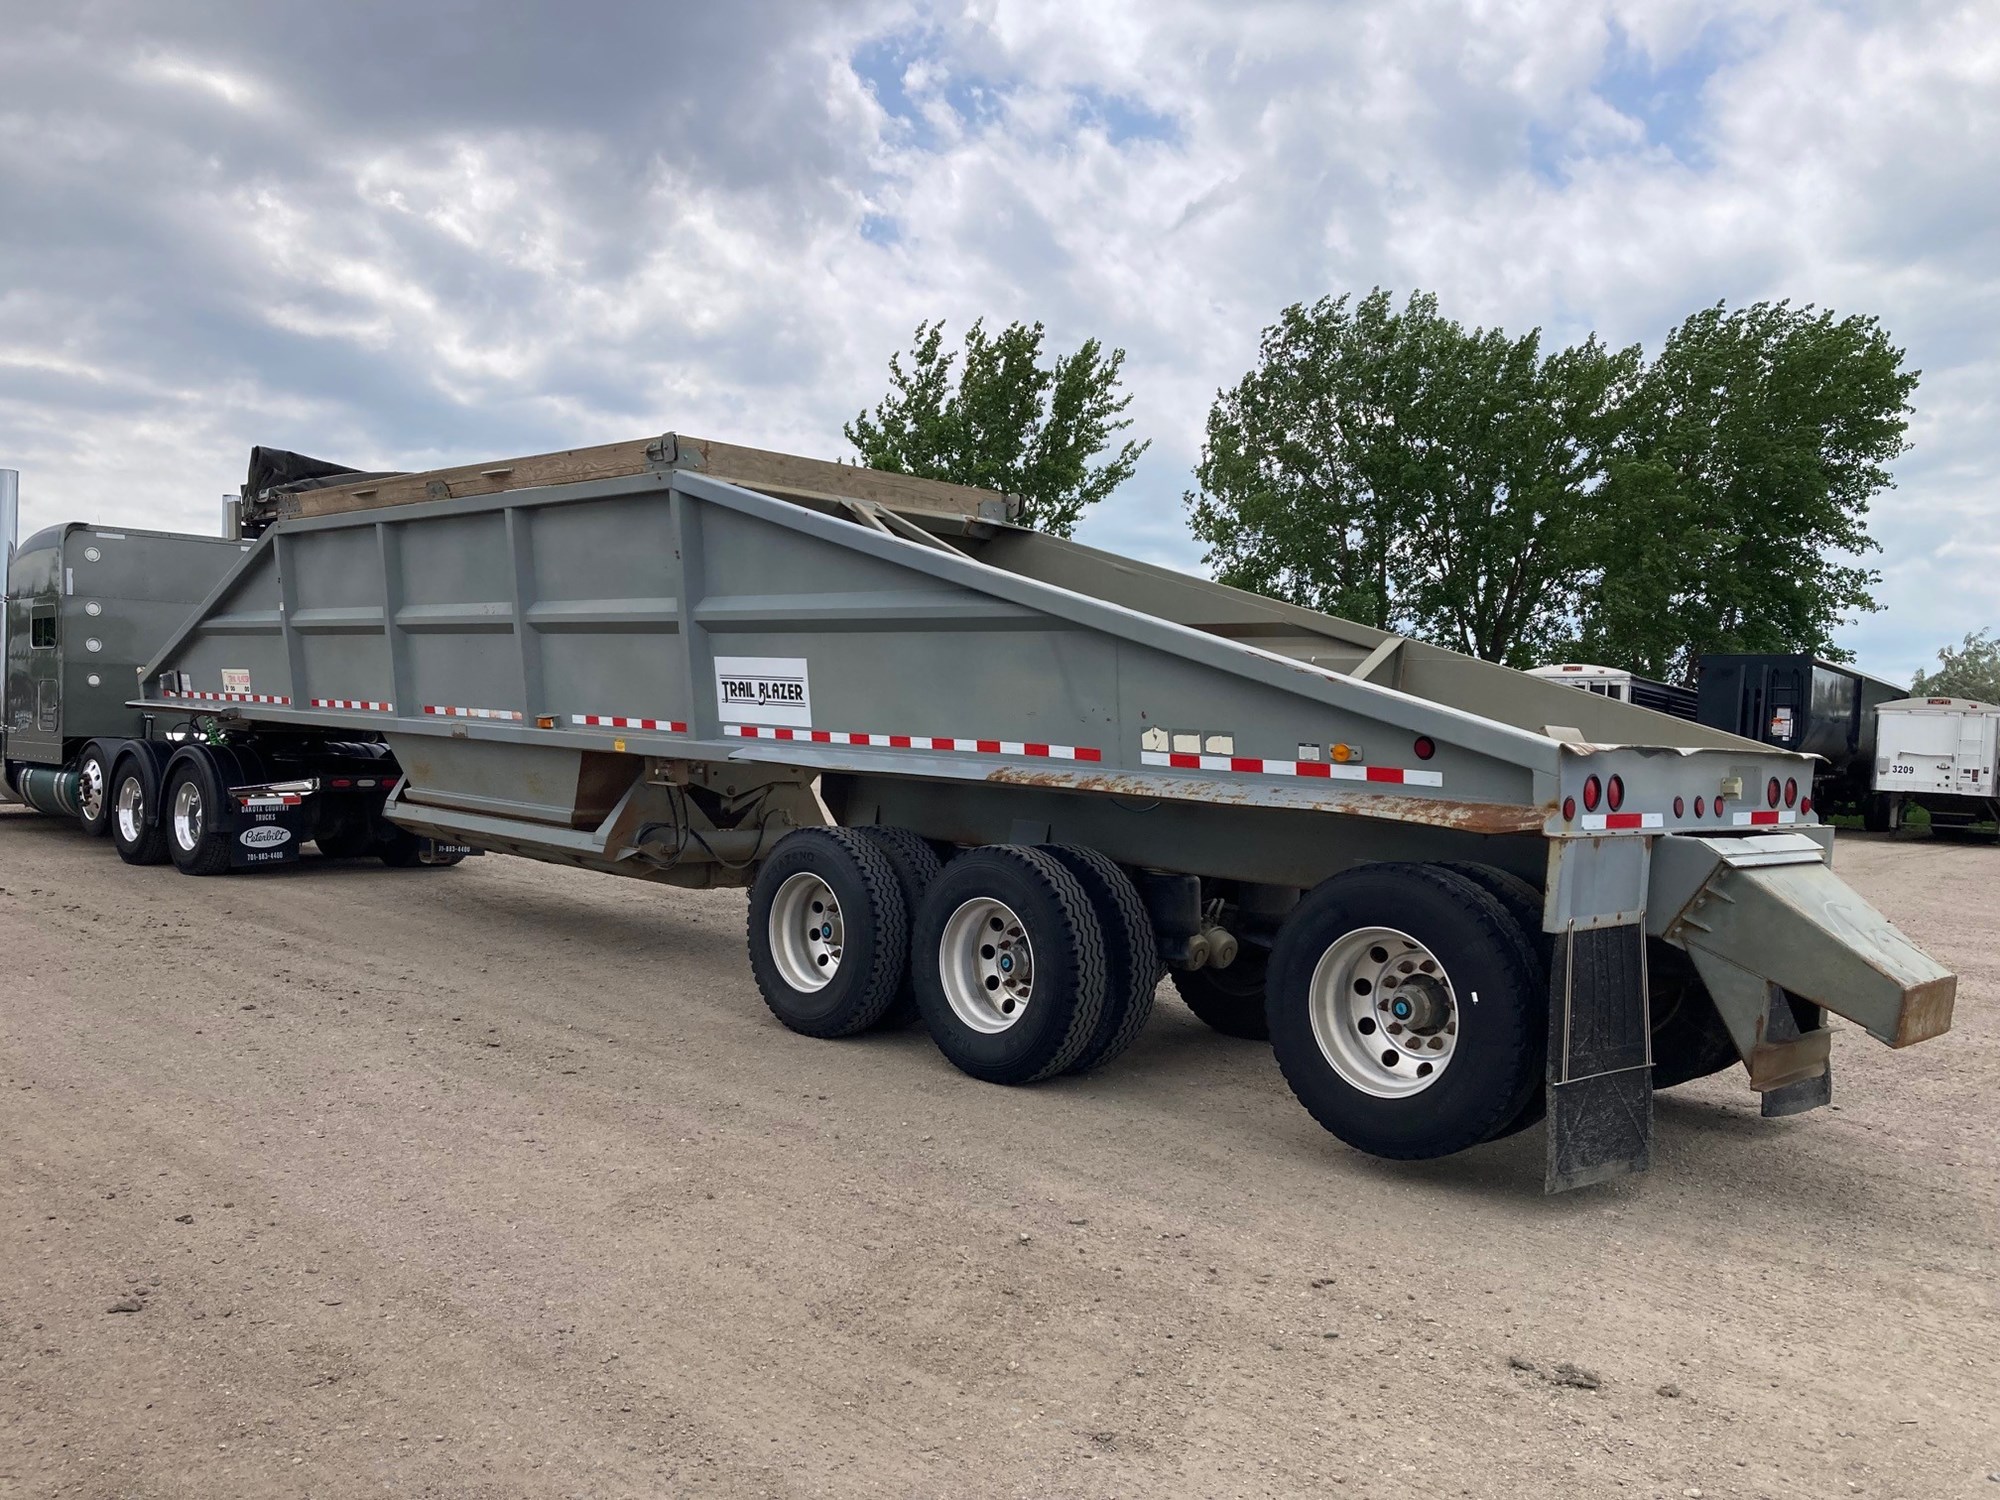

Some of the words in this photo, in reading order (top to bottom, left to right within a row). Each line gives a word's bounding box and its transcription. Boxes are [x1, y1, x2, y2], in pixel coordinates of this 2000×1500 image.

[721, 681, 755, 703] TRAIL
[758, 682, 804, 705] BLAZER
[1892, 765, 1914, 774] 3209
[241, 805, 263, 813] DAKOTA
[265, 804, 289, 812] COUNTRY
[255, 813, 276, 822] TRUCKS
[245, 829, 288, 844] Peterbilt
